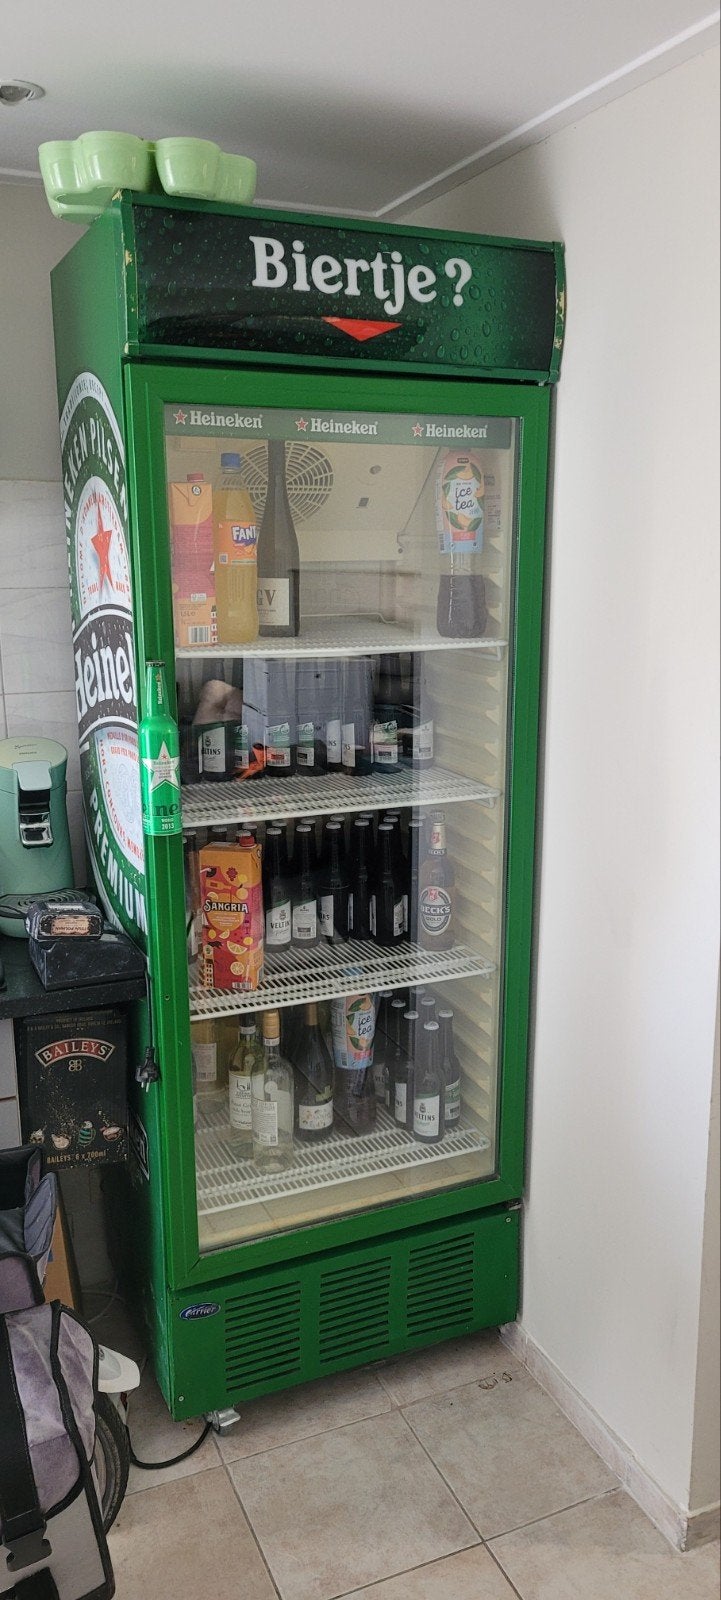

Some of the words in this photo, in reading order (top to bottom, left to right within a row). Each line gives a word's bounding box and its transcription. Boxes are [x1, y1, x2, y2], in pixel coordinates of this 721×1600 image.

[190, 410, 262, 429] Heineken
[310, 418, 378, 436] Heineken
[425, 423, 488, 439] Heineken
[455, 486, 473, 499] ice
[455, 498, 475, 511] tea
[204, 899, 249, 914] SANGRIA
[358, 1015, 372, 1026] ice
[358, 1024, 372, 1036] tea
[42, 1041, 110, 1062] BAILEYS
